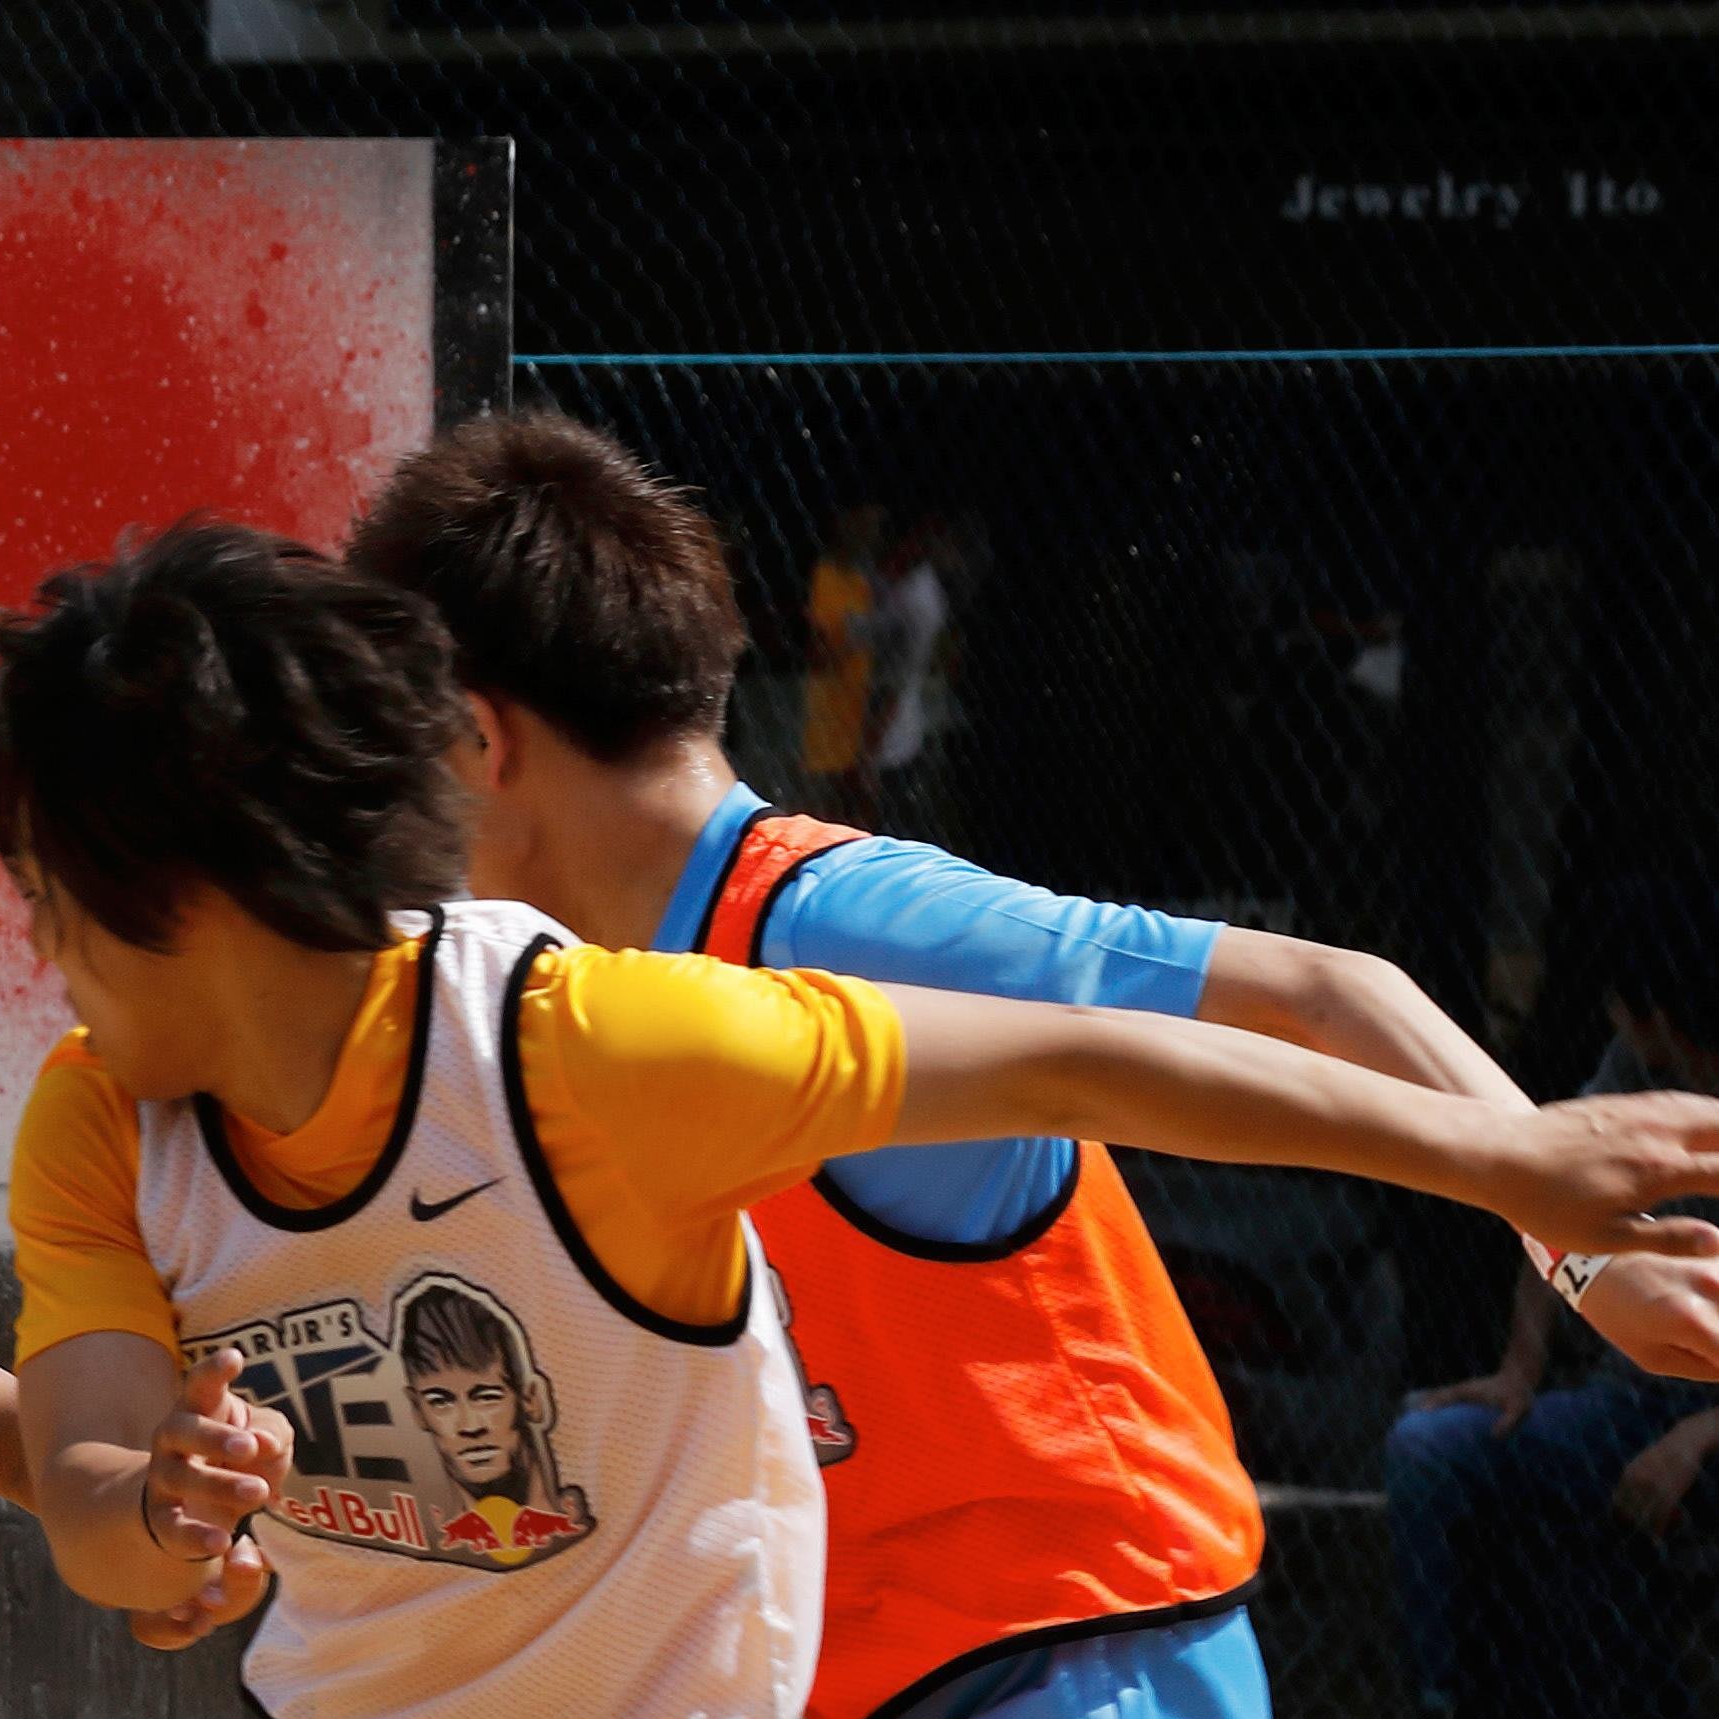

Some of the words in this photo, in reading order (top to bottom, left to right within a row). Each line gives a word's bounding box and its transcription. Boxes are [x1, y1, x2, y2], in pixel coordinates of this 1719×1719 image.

[290, 1311, 353, 1346] JR'S
[285, 1487, 341, 1533] ed
[338, 1492, 427, 1548] Bull
